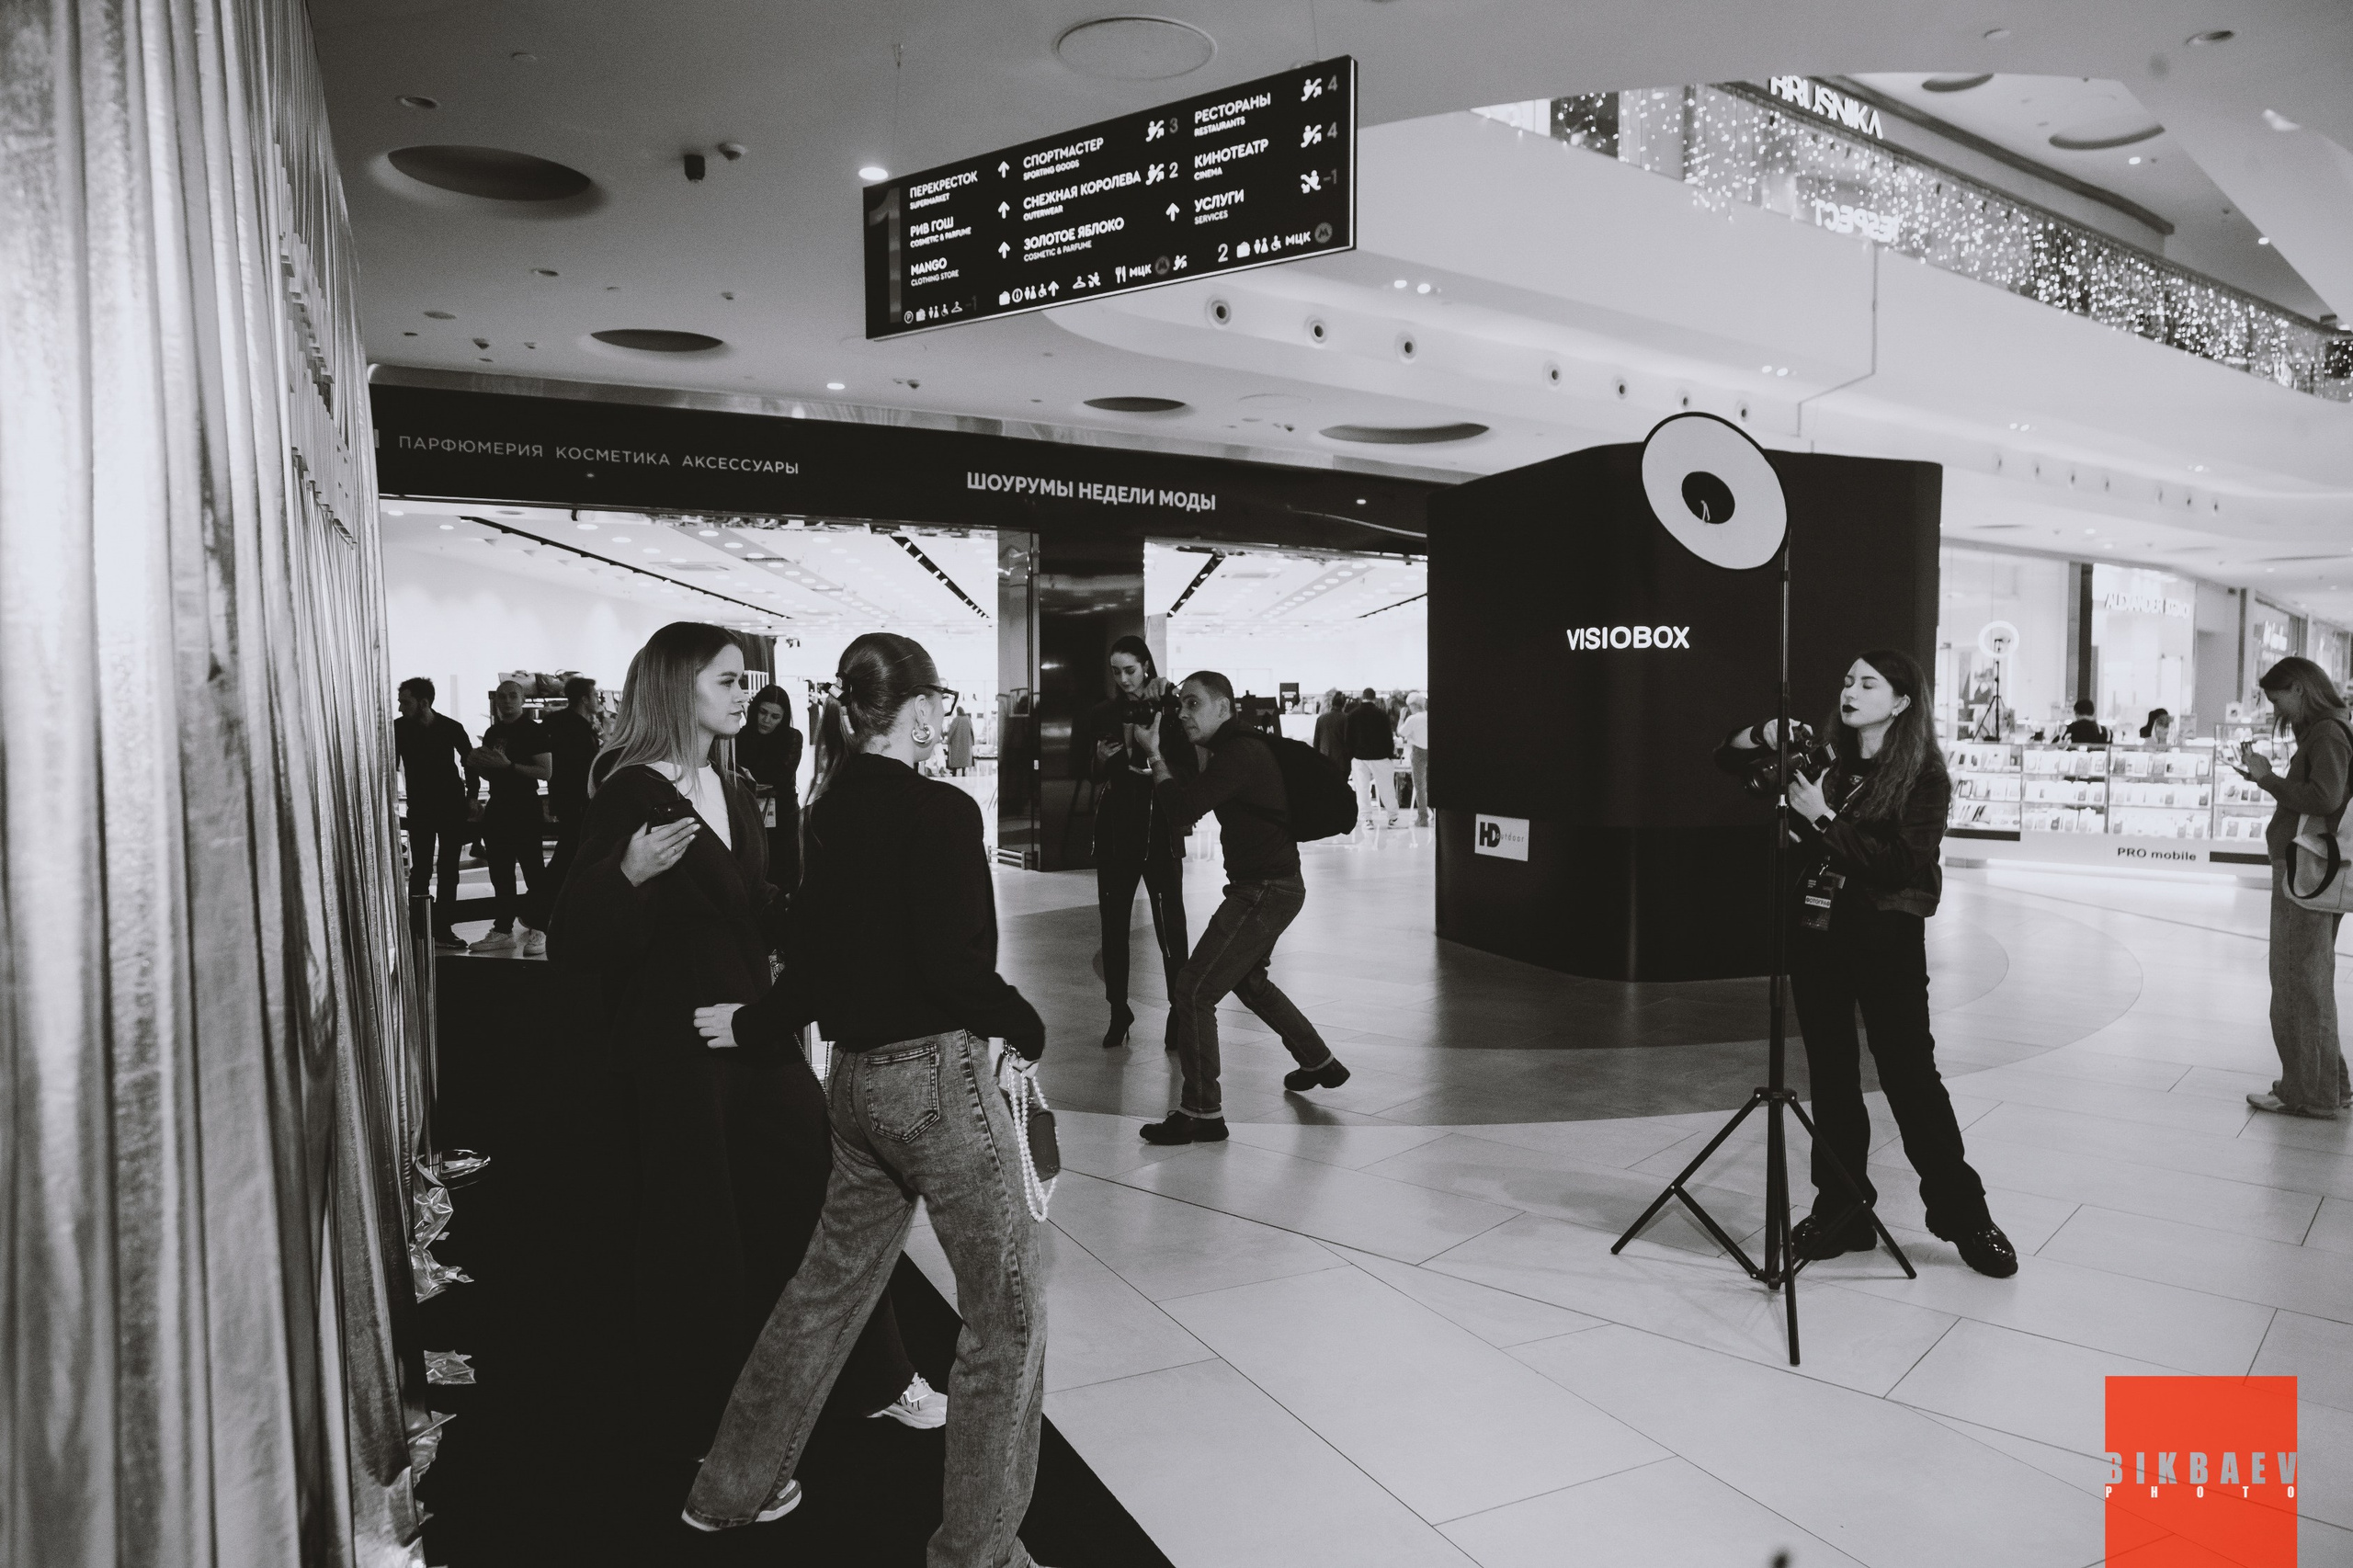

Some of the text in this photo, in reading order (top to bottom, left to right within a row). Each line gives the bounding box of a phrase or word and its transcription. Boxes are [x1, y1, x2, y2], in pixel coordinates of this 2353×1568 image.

[1195, 74, 1337, 123] РЕСТОРАНЫ 4
[1194, 116, 1245, 137] RESTAURANTS
[1023, 117, 1178, 169] СПОРТМАСТЕР 3
[1195, 121, 1337, 168] КИНОТЕАТР 4
[1023, 159, 1080, 181] SPORTING GOODS
[1194, 167, 1222, 181] CINEMA
[910, 170, 978, 199] ПЕРЕКРЕСТОК
[1023, 162, 1178, 210] СНЕЖНАЯ КОРОЛЕВА 2
[910, 193, 950, 210] SUPERMARKET
[1195, 189, 1245, 212] УСЛУГИ
[1023, 205, 1063, 222] OUTERWEAR
[1194, 210, 1228, 225] SERVICES
[910, 216, 954, 237] РИВ ГОШ
[910, 235, 939, 248] COSMETIC
[945, 226, 972, 240] PARFUME
[1024, 217, 1124, 251] ЗОЛОТОЕ ЯБЛОКО
[1024, 246, 1056, 262] COSMETIC
[1063, 240, 1092, 254] PARFUME
[1218, 243, 1228, 263] 2
[1285, 231, 1311, 245] МЦК
[911, 257, 948, 276] MANGO
[1130, 264, 1152, 278] МЦК
[911, 269, 959, 287] CLOTHING STORE
[399, 435, 799, 475] ПАРФЮМЕРИЯ КОСМЕТИКА АКСЕССУАРЫ
[967, 472, 1216, 513] ШОУРУМЫ НЕДЕЛИ МОДЫ
[1566, 626, 1690, 650] VISIOBOX
[1479, 821, 1500, 847] HD
[2117, 847, 2197, 861] PRO mobile
